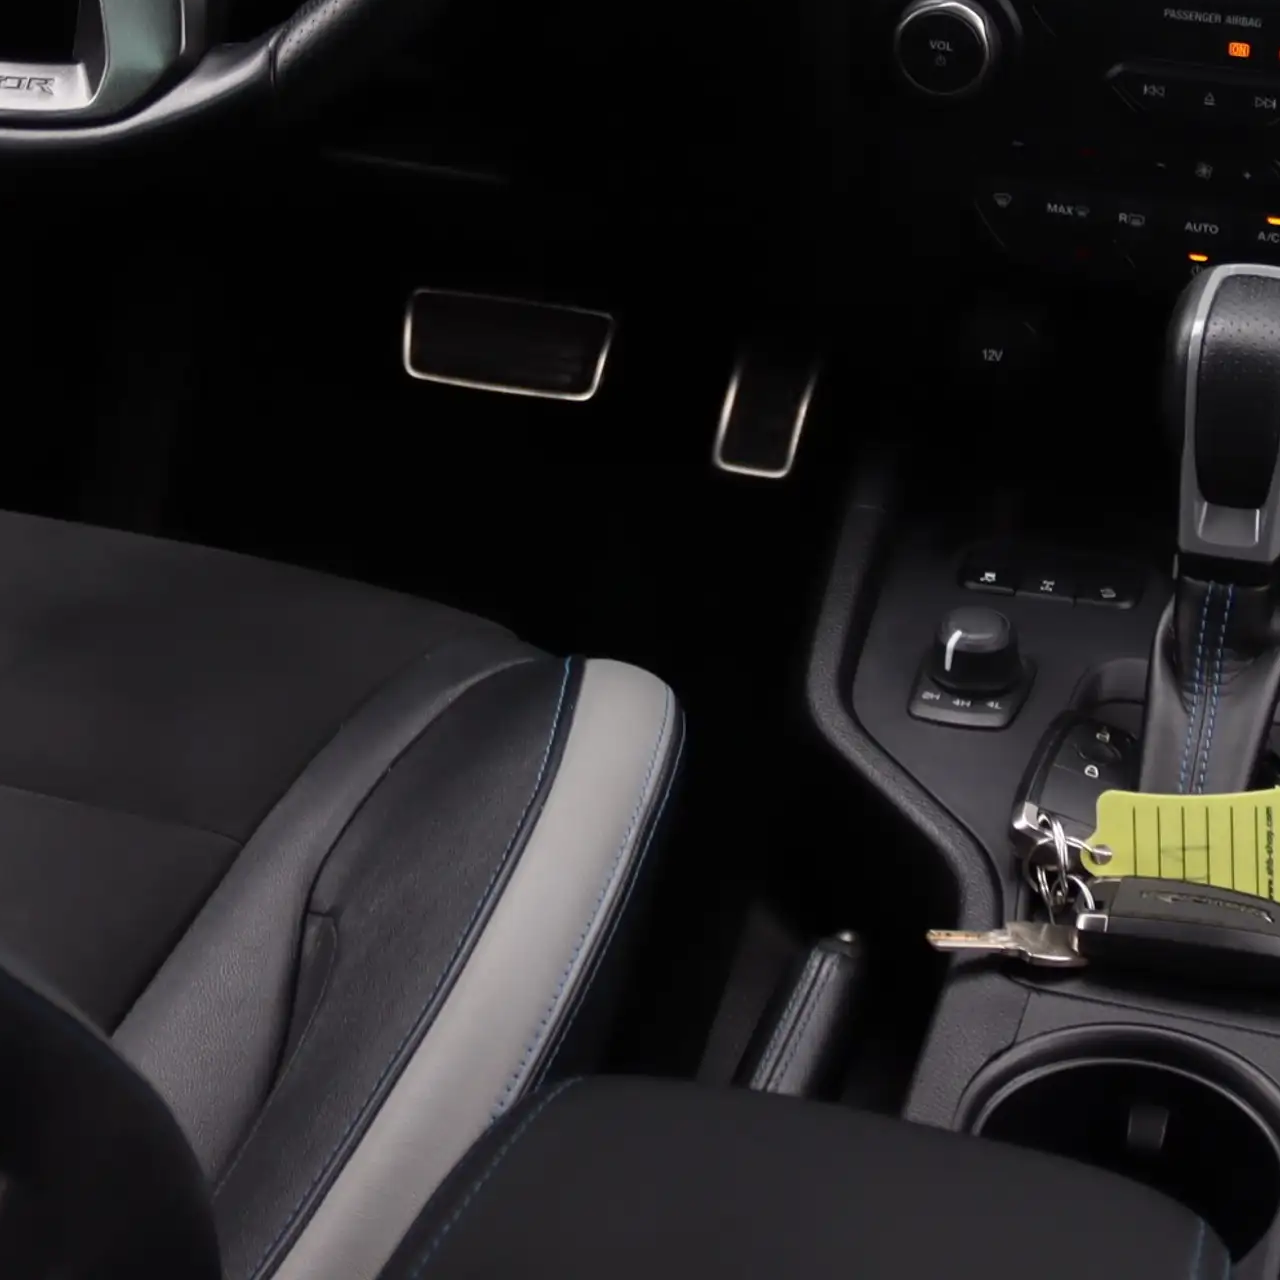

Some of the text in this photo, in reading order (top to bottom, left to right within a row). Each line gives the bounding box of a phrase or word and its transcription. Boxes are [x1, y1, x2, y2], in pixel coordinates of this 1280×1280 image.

[1163, 7, 1263, 29] PASSENGER AIRBAG
[928, 38, 954, 53] VOL
[1231, 43, 1249, 57] ON
[1046, 202, 1280, 244] MAX R AUTO A/C
[981, 347, 1004, 362] 12V
